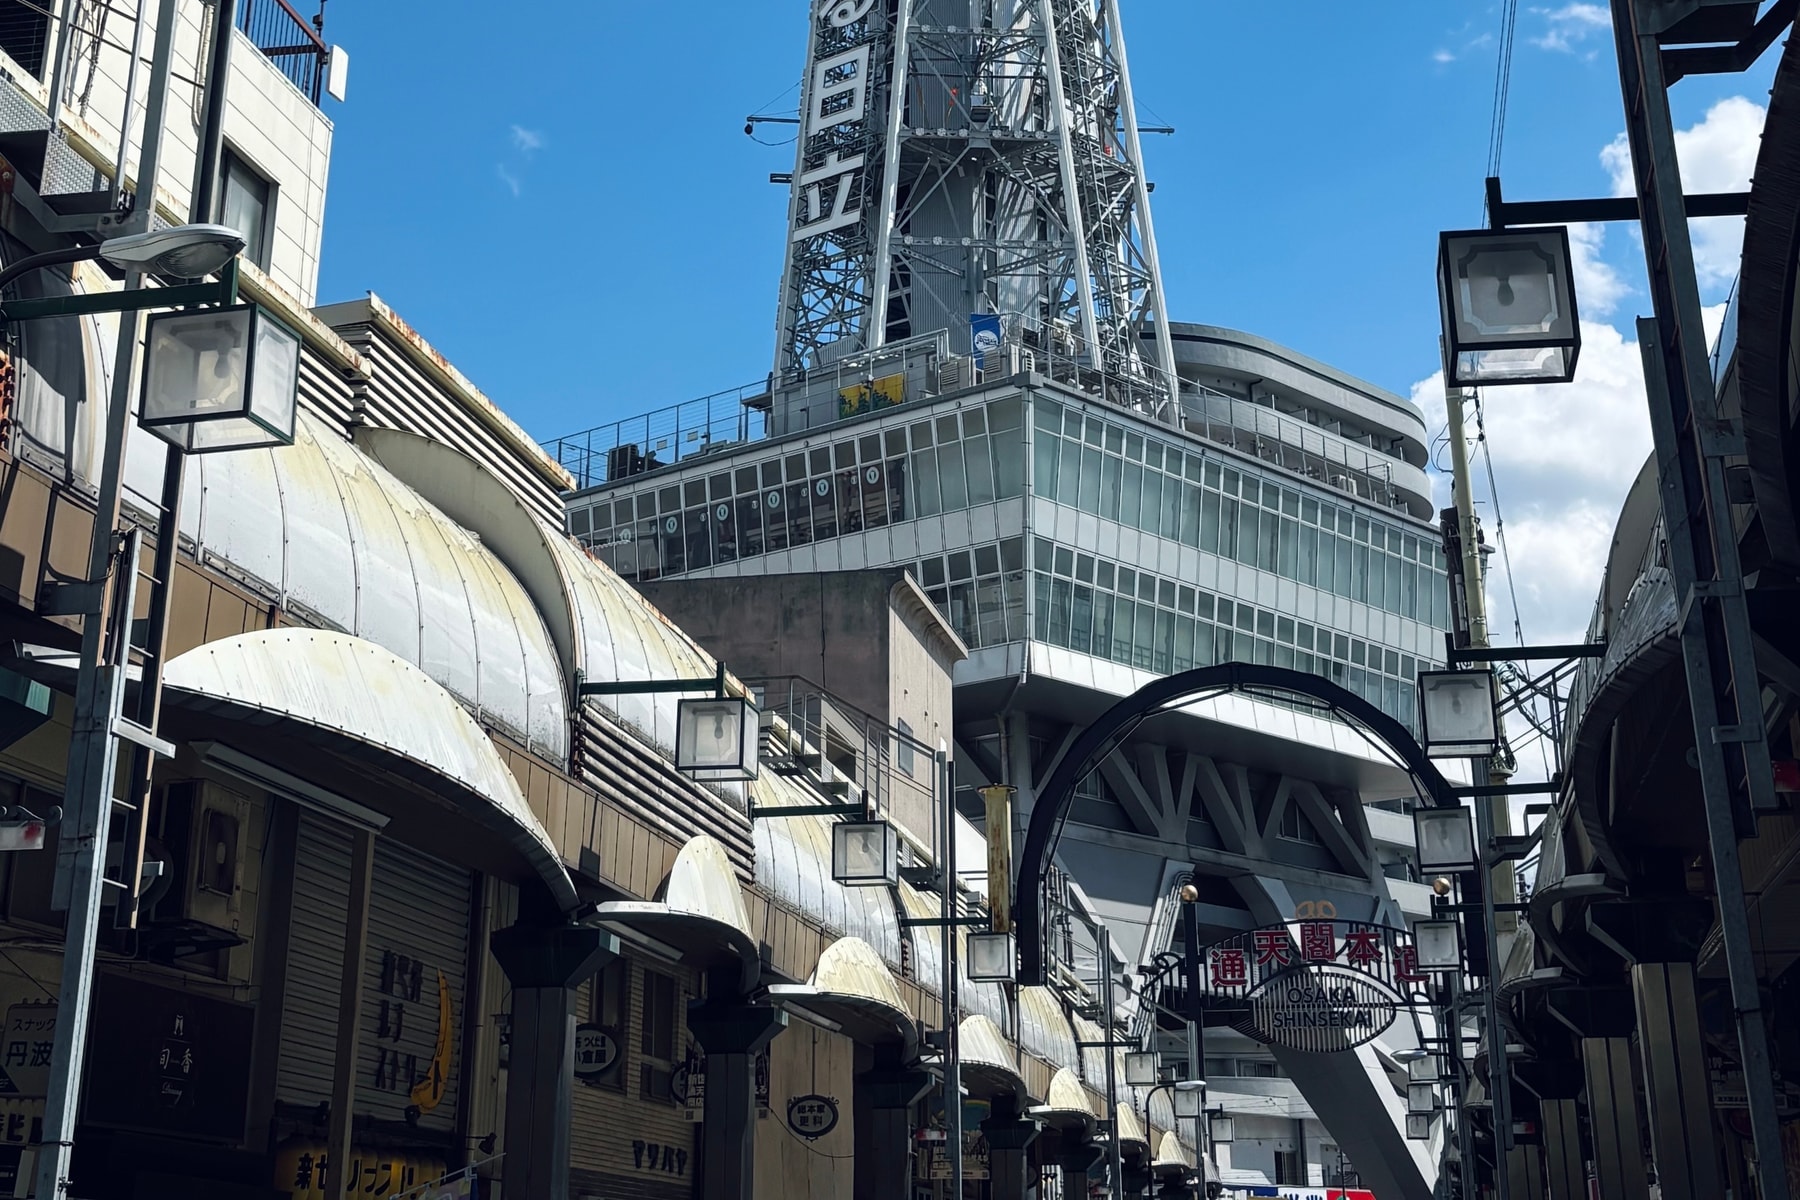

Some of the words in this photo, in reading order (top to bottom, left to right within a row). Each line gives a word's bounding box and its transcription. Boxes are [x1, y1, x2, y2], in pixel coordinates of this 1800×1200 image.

[1287, 987, 1357, 1004] OSAKA
[12, 1017, 57, 1032] スナック
[1273, 1010, 1374, 1029] SHINSEKAI
[5, 1040, 54, 1068] 丹波
